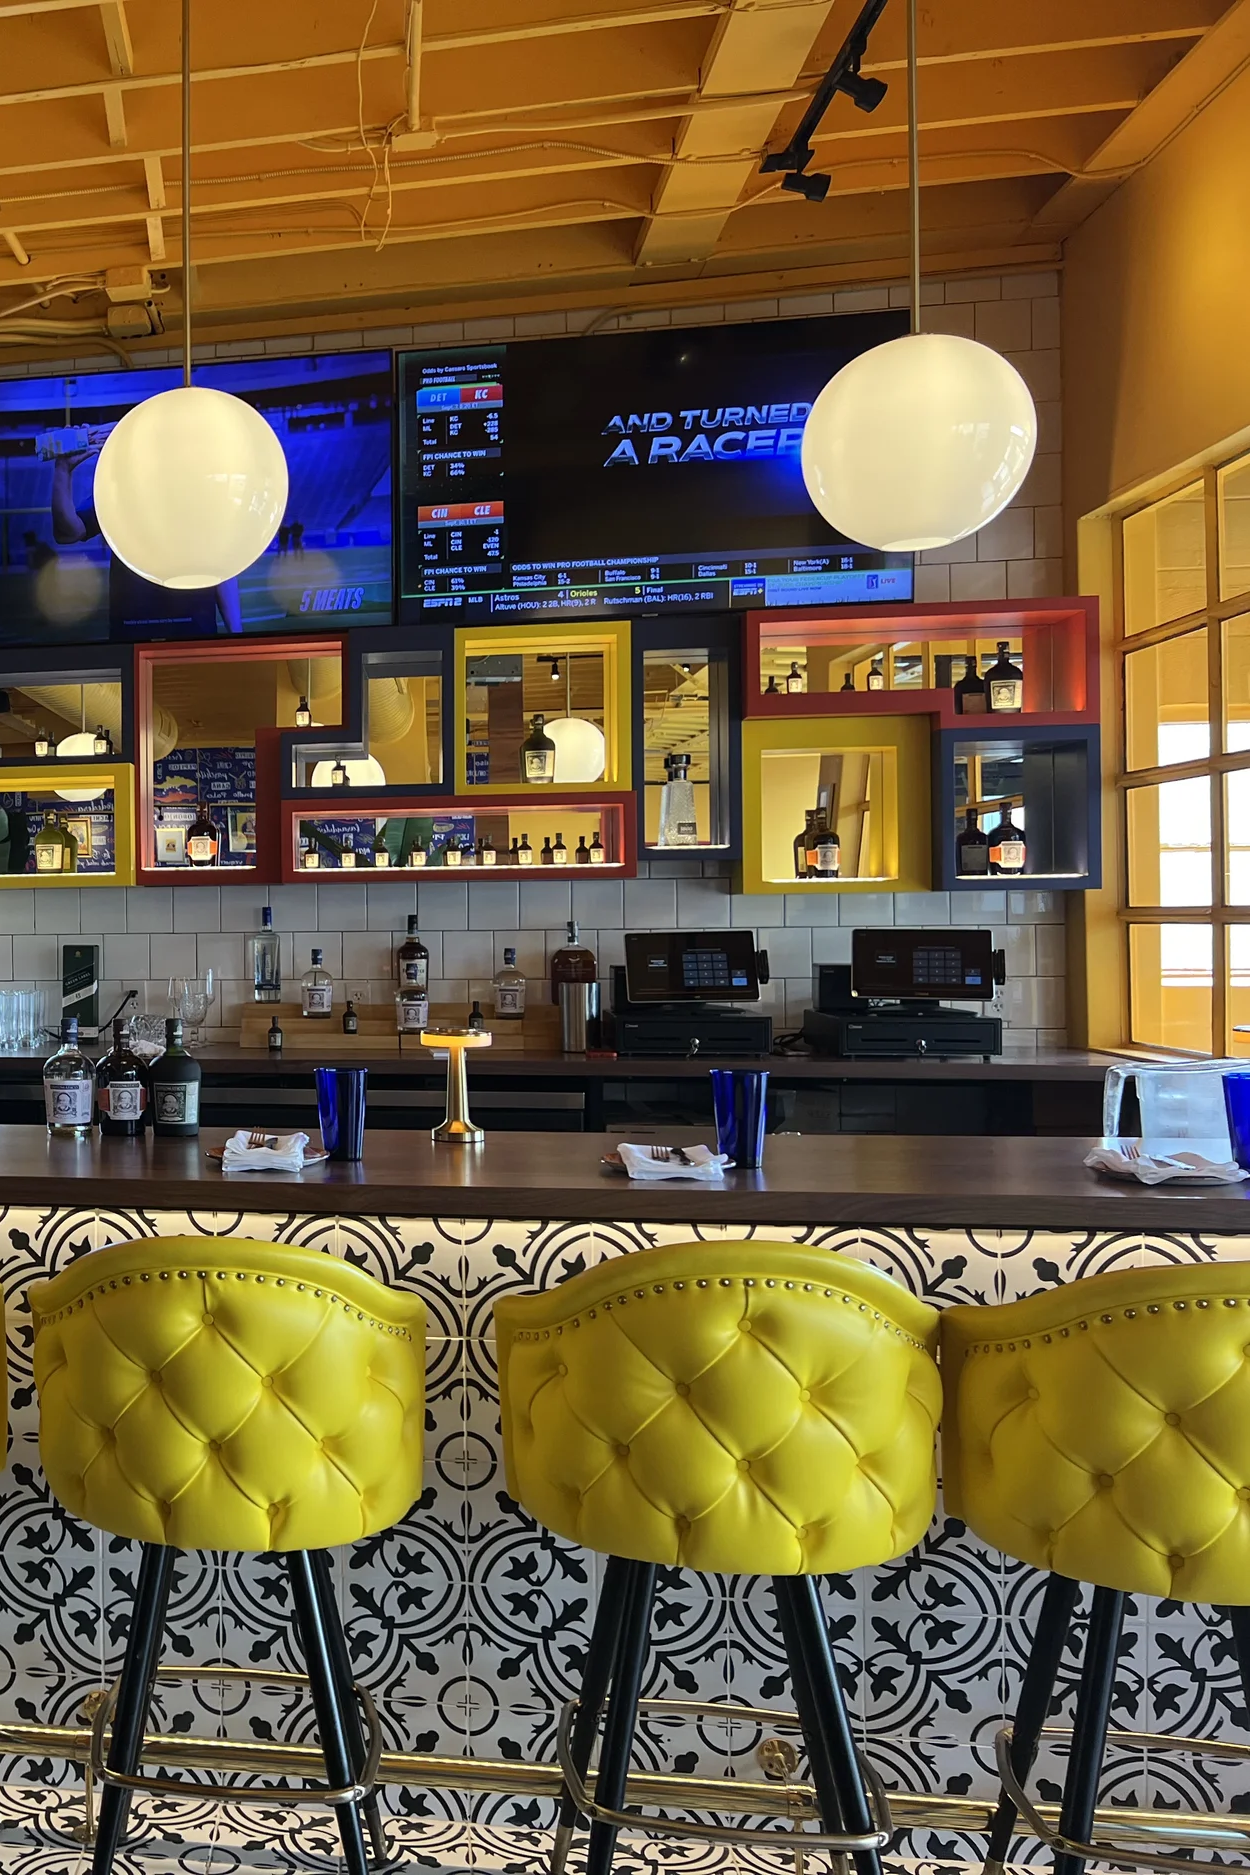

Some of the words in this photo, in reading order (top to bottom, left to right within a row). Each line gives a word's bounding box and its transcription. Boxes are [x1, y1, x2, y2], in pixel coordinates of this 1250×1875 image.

[430, 393, 447, 402] DET
[475, 389, 488, 400] KC
[601, 412, 673, 435] AND
[679, 402, 813, 430] TURNED
[434, 451, 461, 460] CHANCE
[603, 439, 639, 467] A
[431, 508, 448, 518] CIN
[474, 505, 491, 515] CLE
[607, 557, 659, 566] CHAMPIONSHIP
[435, 567, 462, 575] CHANCE
[474, 565, 487, 573] WIN
[300, 591, 312, 612] 5
[312, 587, 364, 611] MEATS
